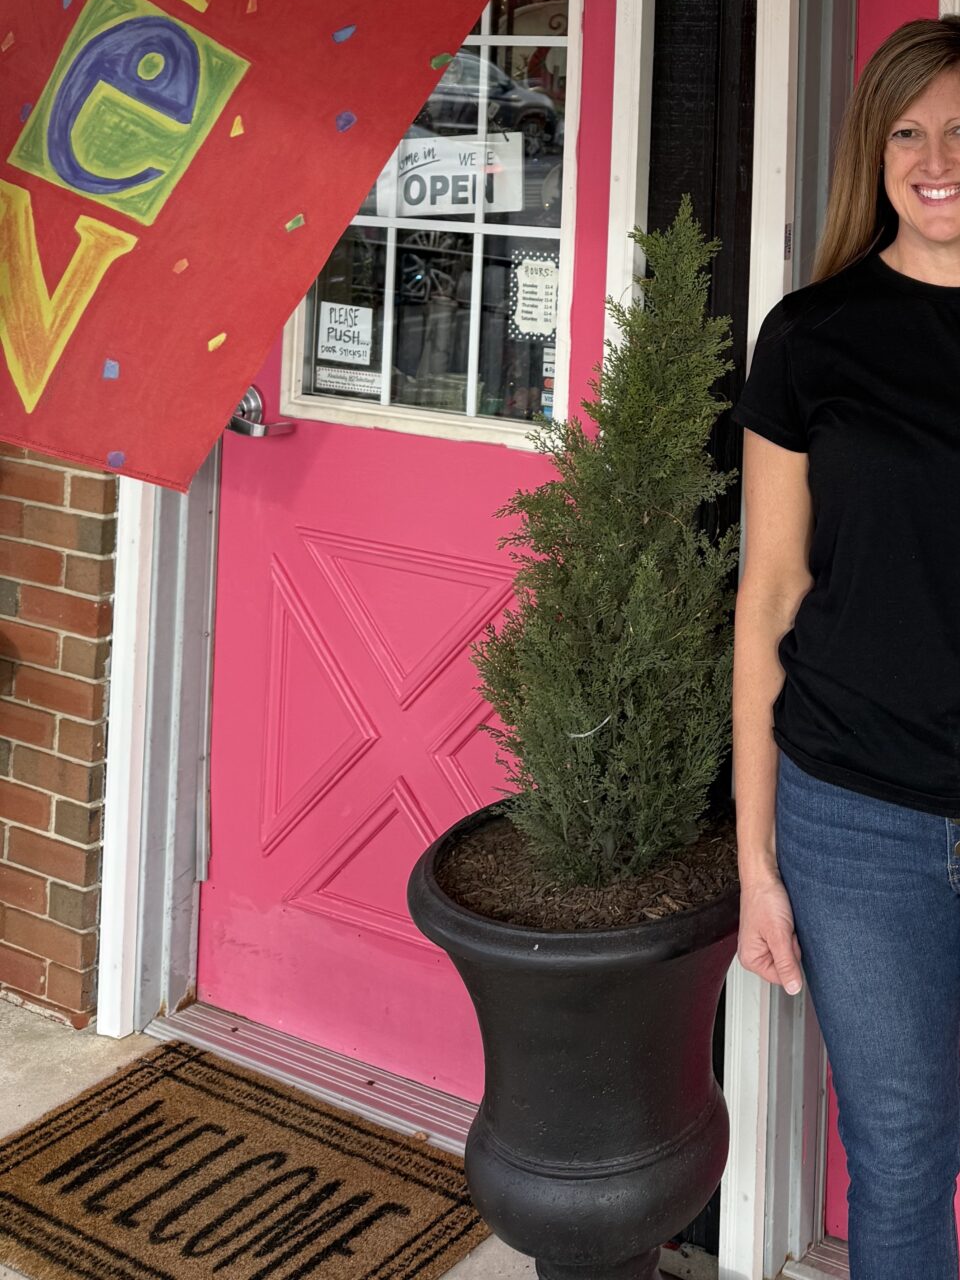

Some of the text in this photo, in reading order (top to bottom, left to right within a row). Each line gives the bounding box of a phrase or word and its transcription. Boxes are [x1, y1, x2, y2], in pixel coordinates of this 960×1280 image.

[399, 146, 437, 170] ome in
[329, 306, 360, 328] PLEASE
[320, 339, 338, 354] DOOR
[37, 1098, 411, 1280] WELCOME
